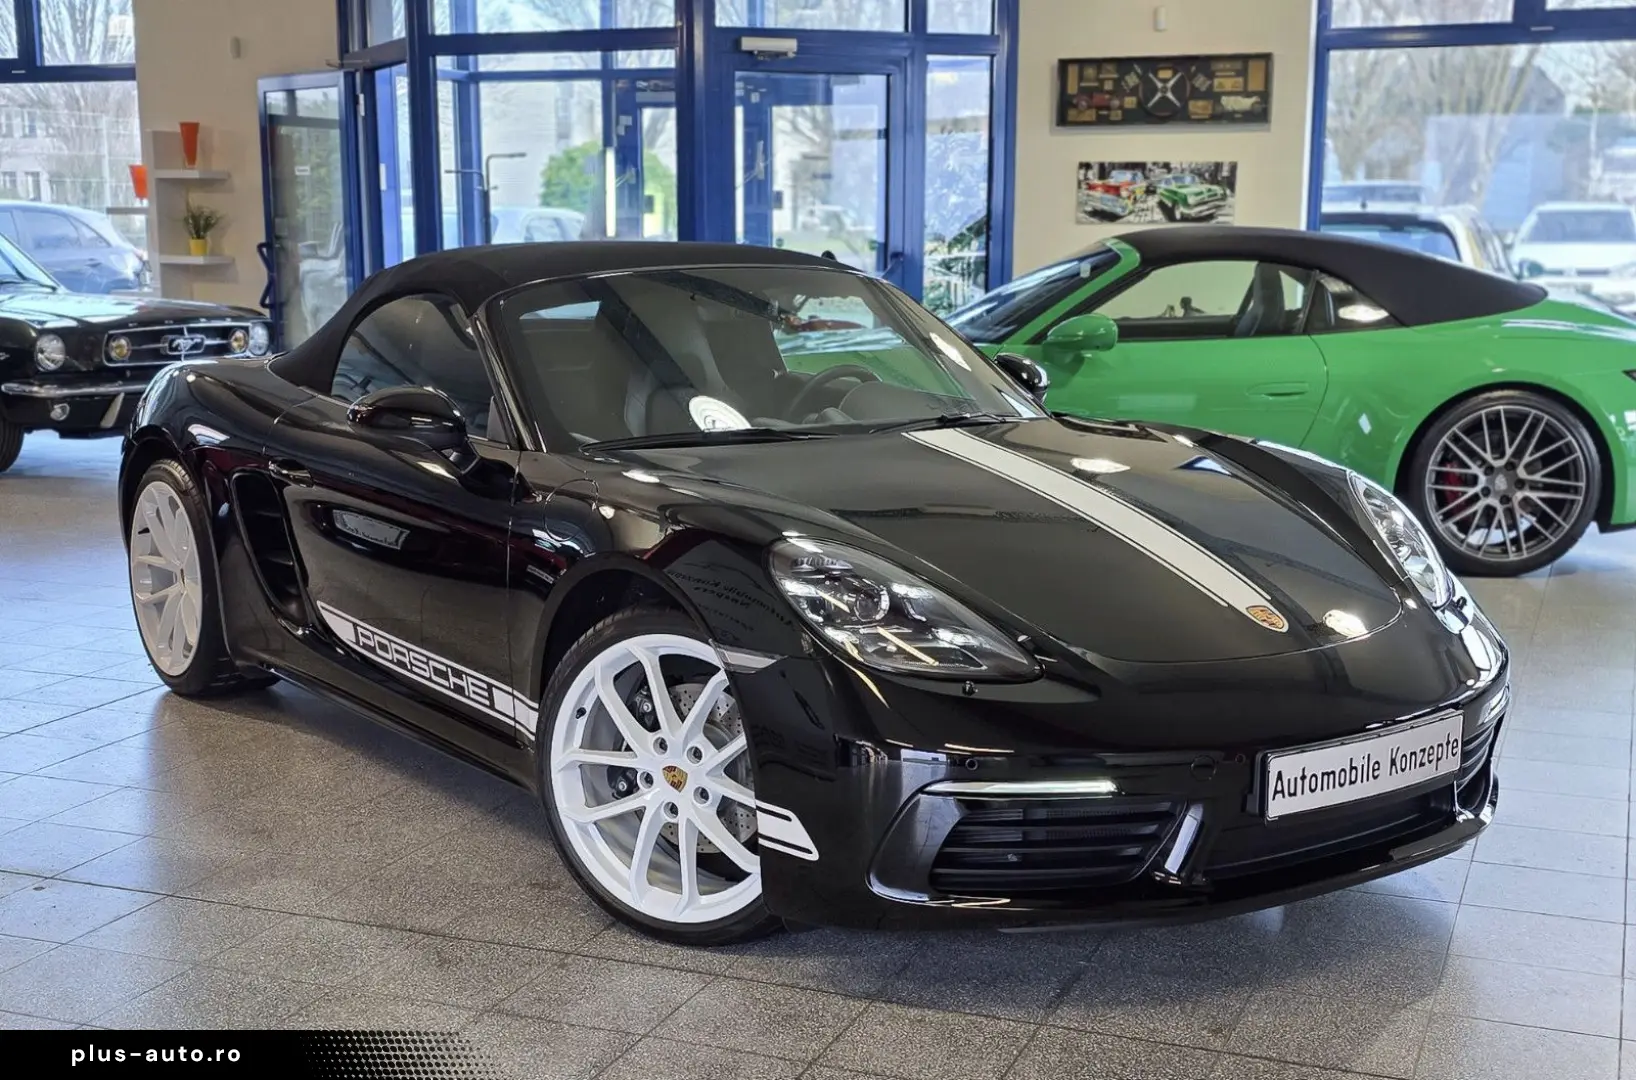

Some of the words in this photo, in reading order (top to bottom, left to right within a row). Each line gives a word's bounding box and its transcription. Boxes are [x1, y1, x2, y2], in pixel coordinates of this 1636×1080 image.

[356, 625, 491, 706] PORSCHE
[1272, 753, 1381, 801] Automobile
[1389, 732, 1460, 776] Konzepte
